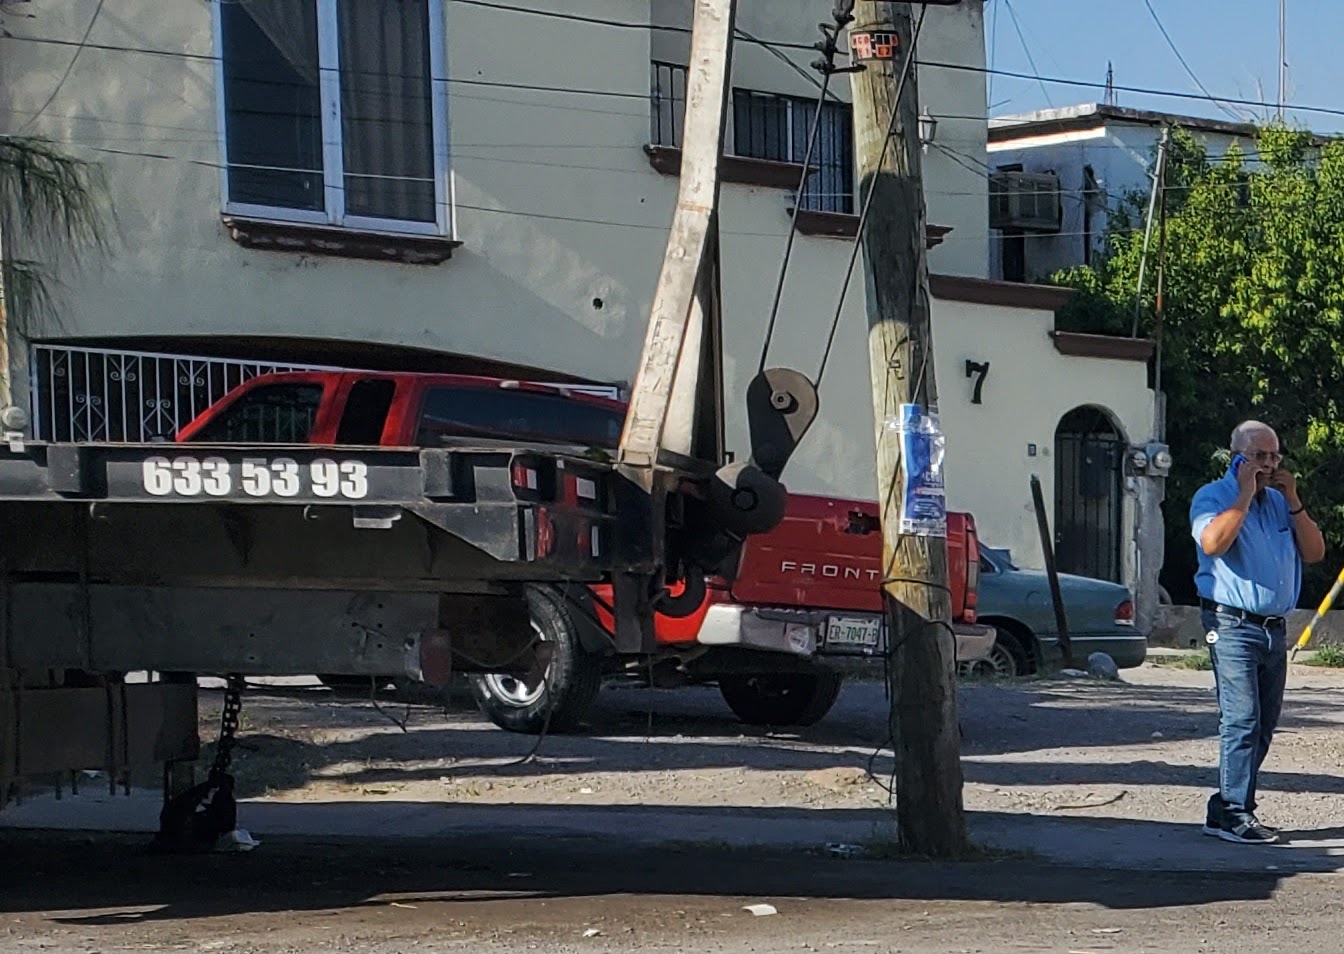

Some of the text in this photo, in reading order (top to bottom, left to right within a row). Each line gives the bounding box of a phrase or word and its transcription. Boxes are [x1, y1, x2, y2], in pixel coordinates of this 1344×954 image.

[966, 359, 990, 405] 7
[143, 456, 368, 499] 633 53 93
